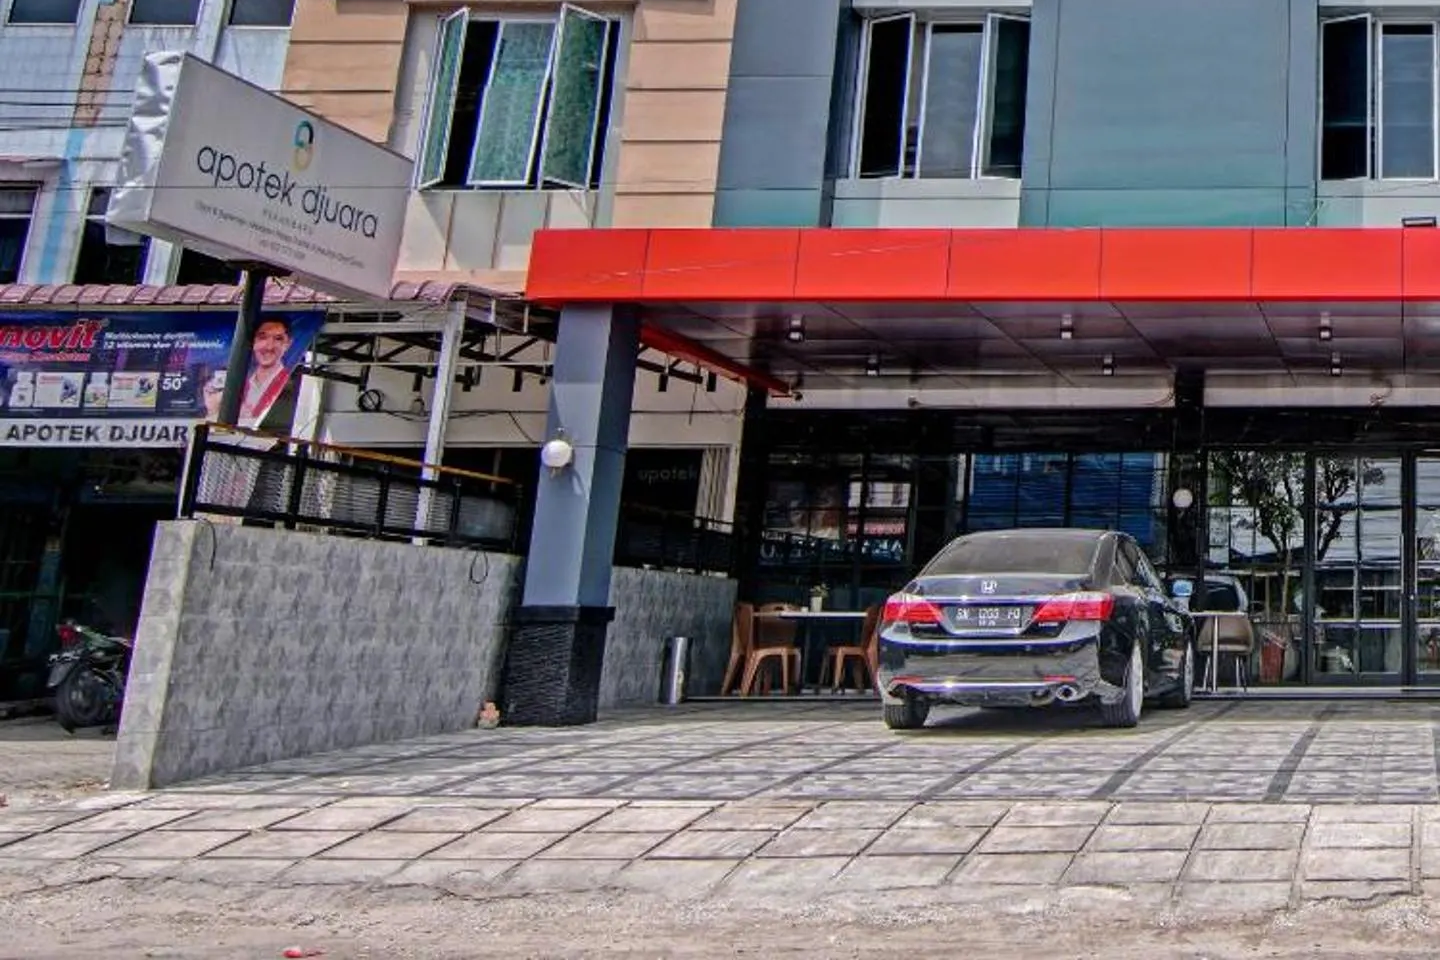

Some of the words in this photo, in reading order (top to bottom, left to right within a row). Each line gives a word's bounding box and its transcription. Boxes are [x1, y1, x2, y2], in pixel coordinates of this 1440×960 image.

[197, 144, 296, 209] apotek
[302, 184, 379, 239] djuara
[7, 424, 103, 442] APOTEK
